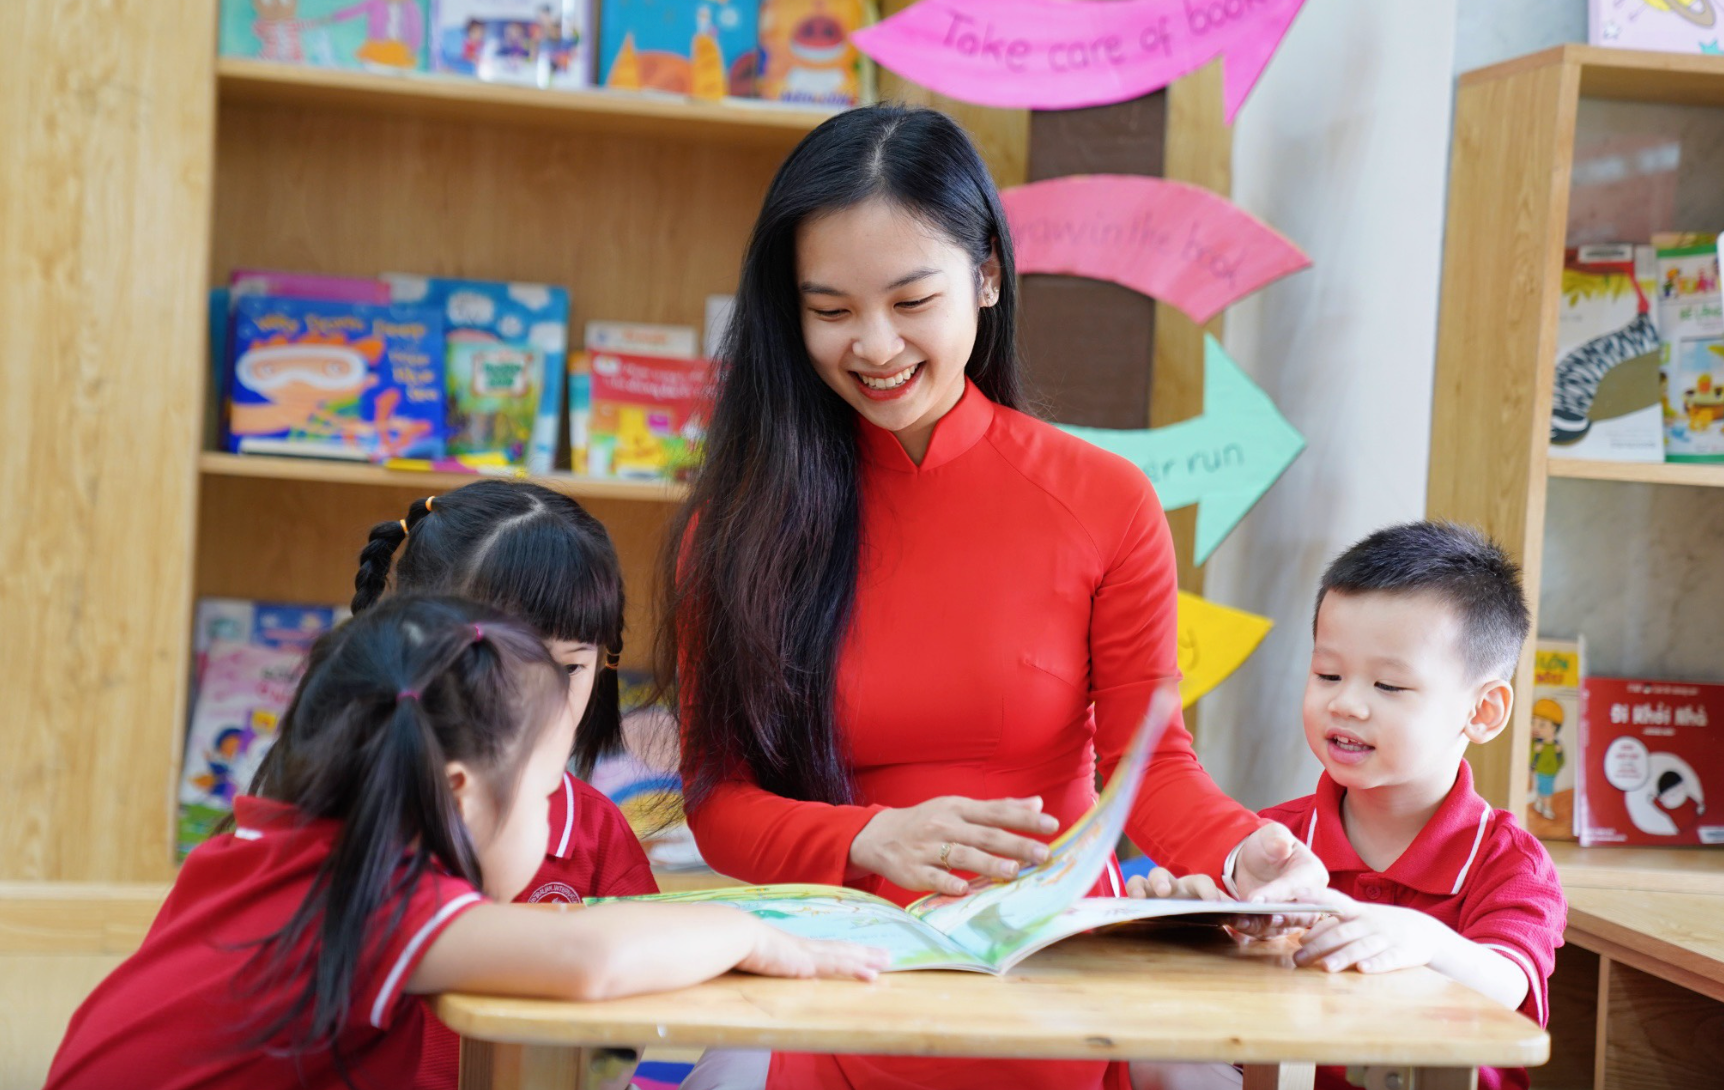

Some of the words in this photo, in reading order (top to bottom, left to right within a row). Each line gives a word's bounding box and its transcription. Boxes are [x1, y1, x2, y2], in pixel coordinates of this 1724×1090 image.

[943, 12, 1032, 73] Take
[1048, 34, 1126, 73] care
[1139, 15, 1172, 57] of
[1182, 0, 1266, 36] boo
[1186, 442, 1246, 475] run
